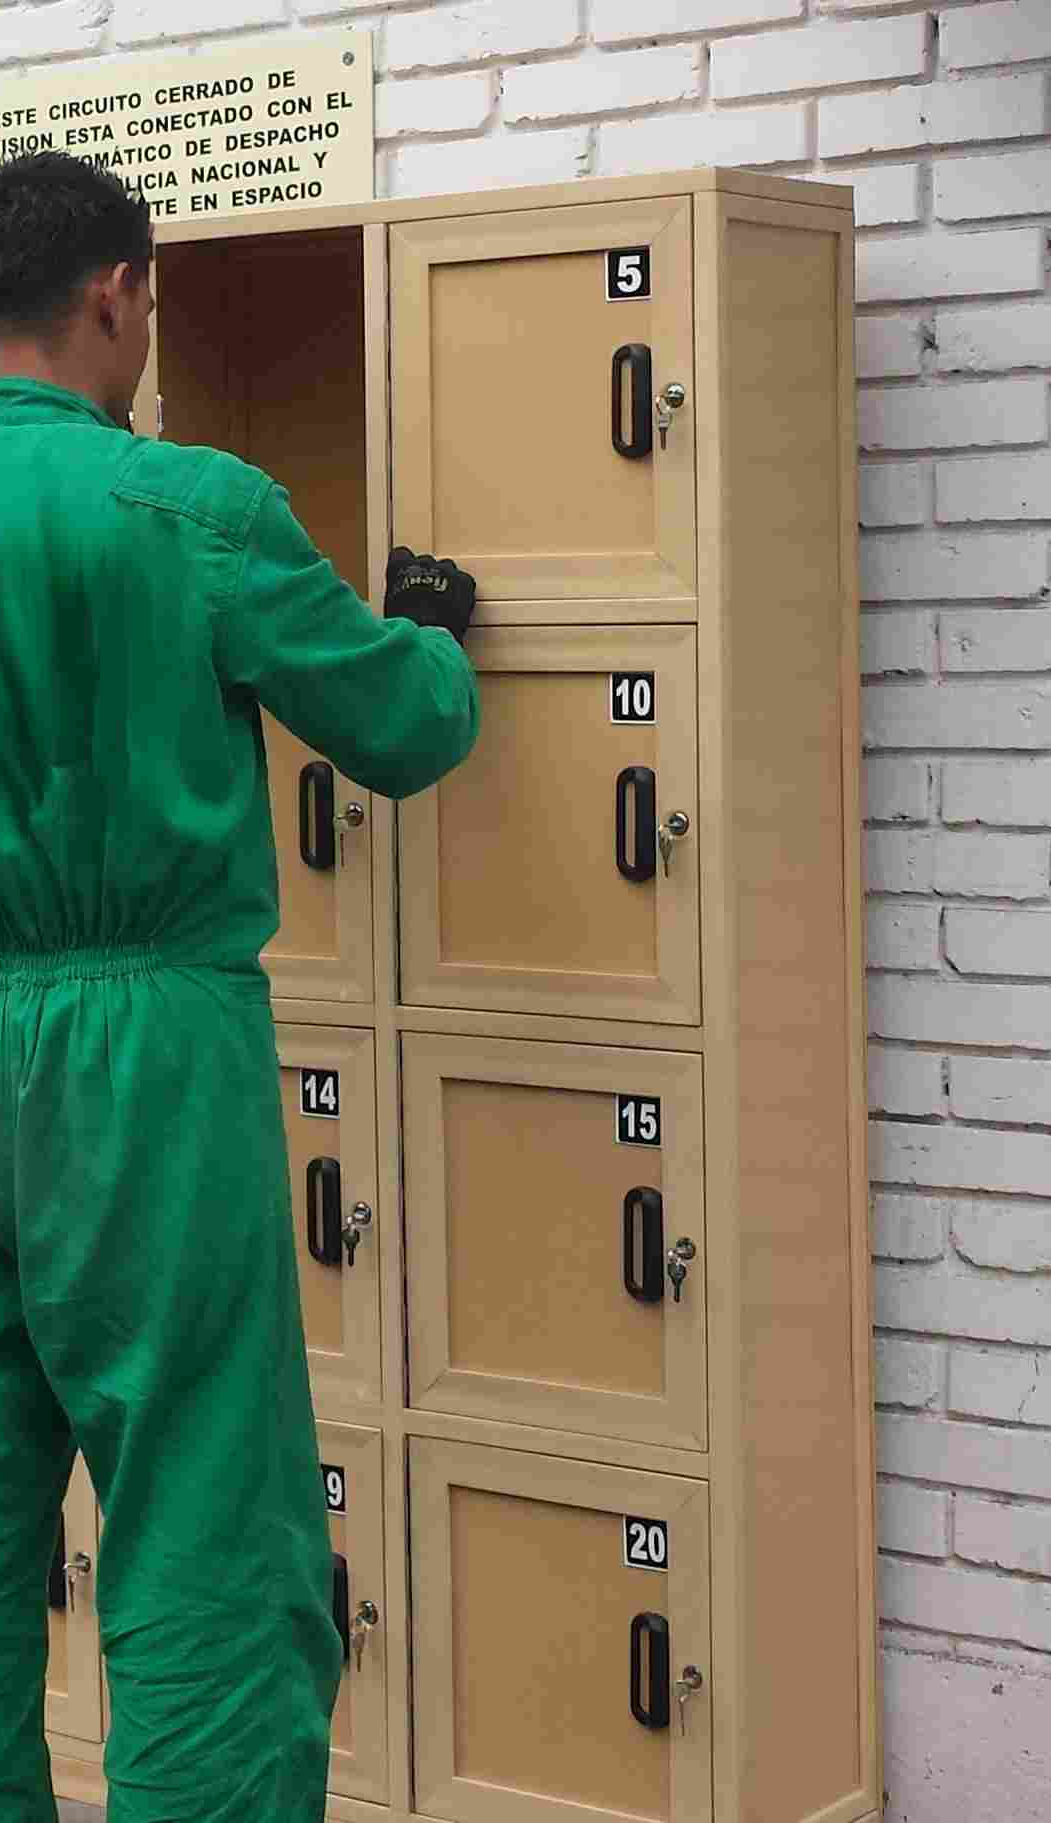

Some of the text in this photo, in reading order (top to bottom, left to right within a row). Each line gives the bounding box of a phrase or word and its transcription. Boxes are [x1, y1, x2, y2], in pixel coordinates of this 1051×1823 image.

[48, 93, 142, 121] CIRCUITO
[154, 76, 254, 105] CERRADO
[267, 70, 296, 89] DE
[65, 125, 114, 145] ESTA
[126, 105, 253, 137] CONECTADO
[267, 96, 312, 118] CON
[326, 91, 352, 110] EL
[82, 144, 172, 169] OMÁTICO
[185, 138, 212, 157] DE
[226, 121, 339, 152] DESPACHO
[116, 151, 328, 192] LICIA NACIONAL Y
[152, 181, 322, 216] TE EN ESPACIO
[616, 255, 642, 293] 5
[616, 678, 651, 716] 10
[304, 1074, 336, 1111] 14
[622, 1101, 657, 1140] 15
[326, 1471, 343, 1506] 9
[629, 1523, 665, 1563] 20
